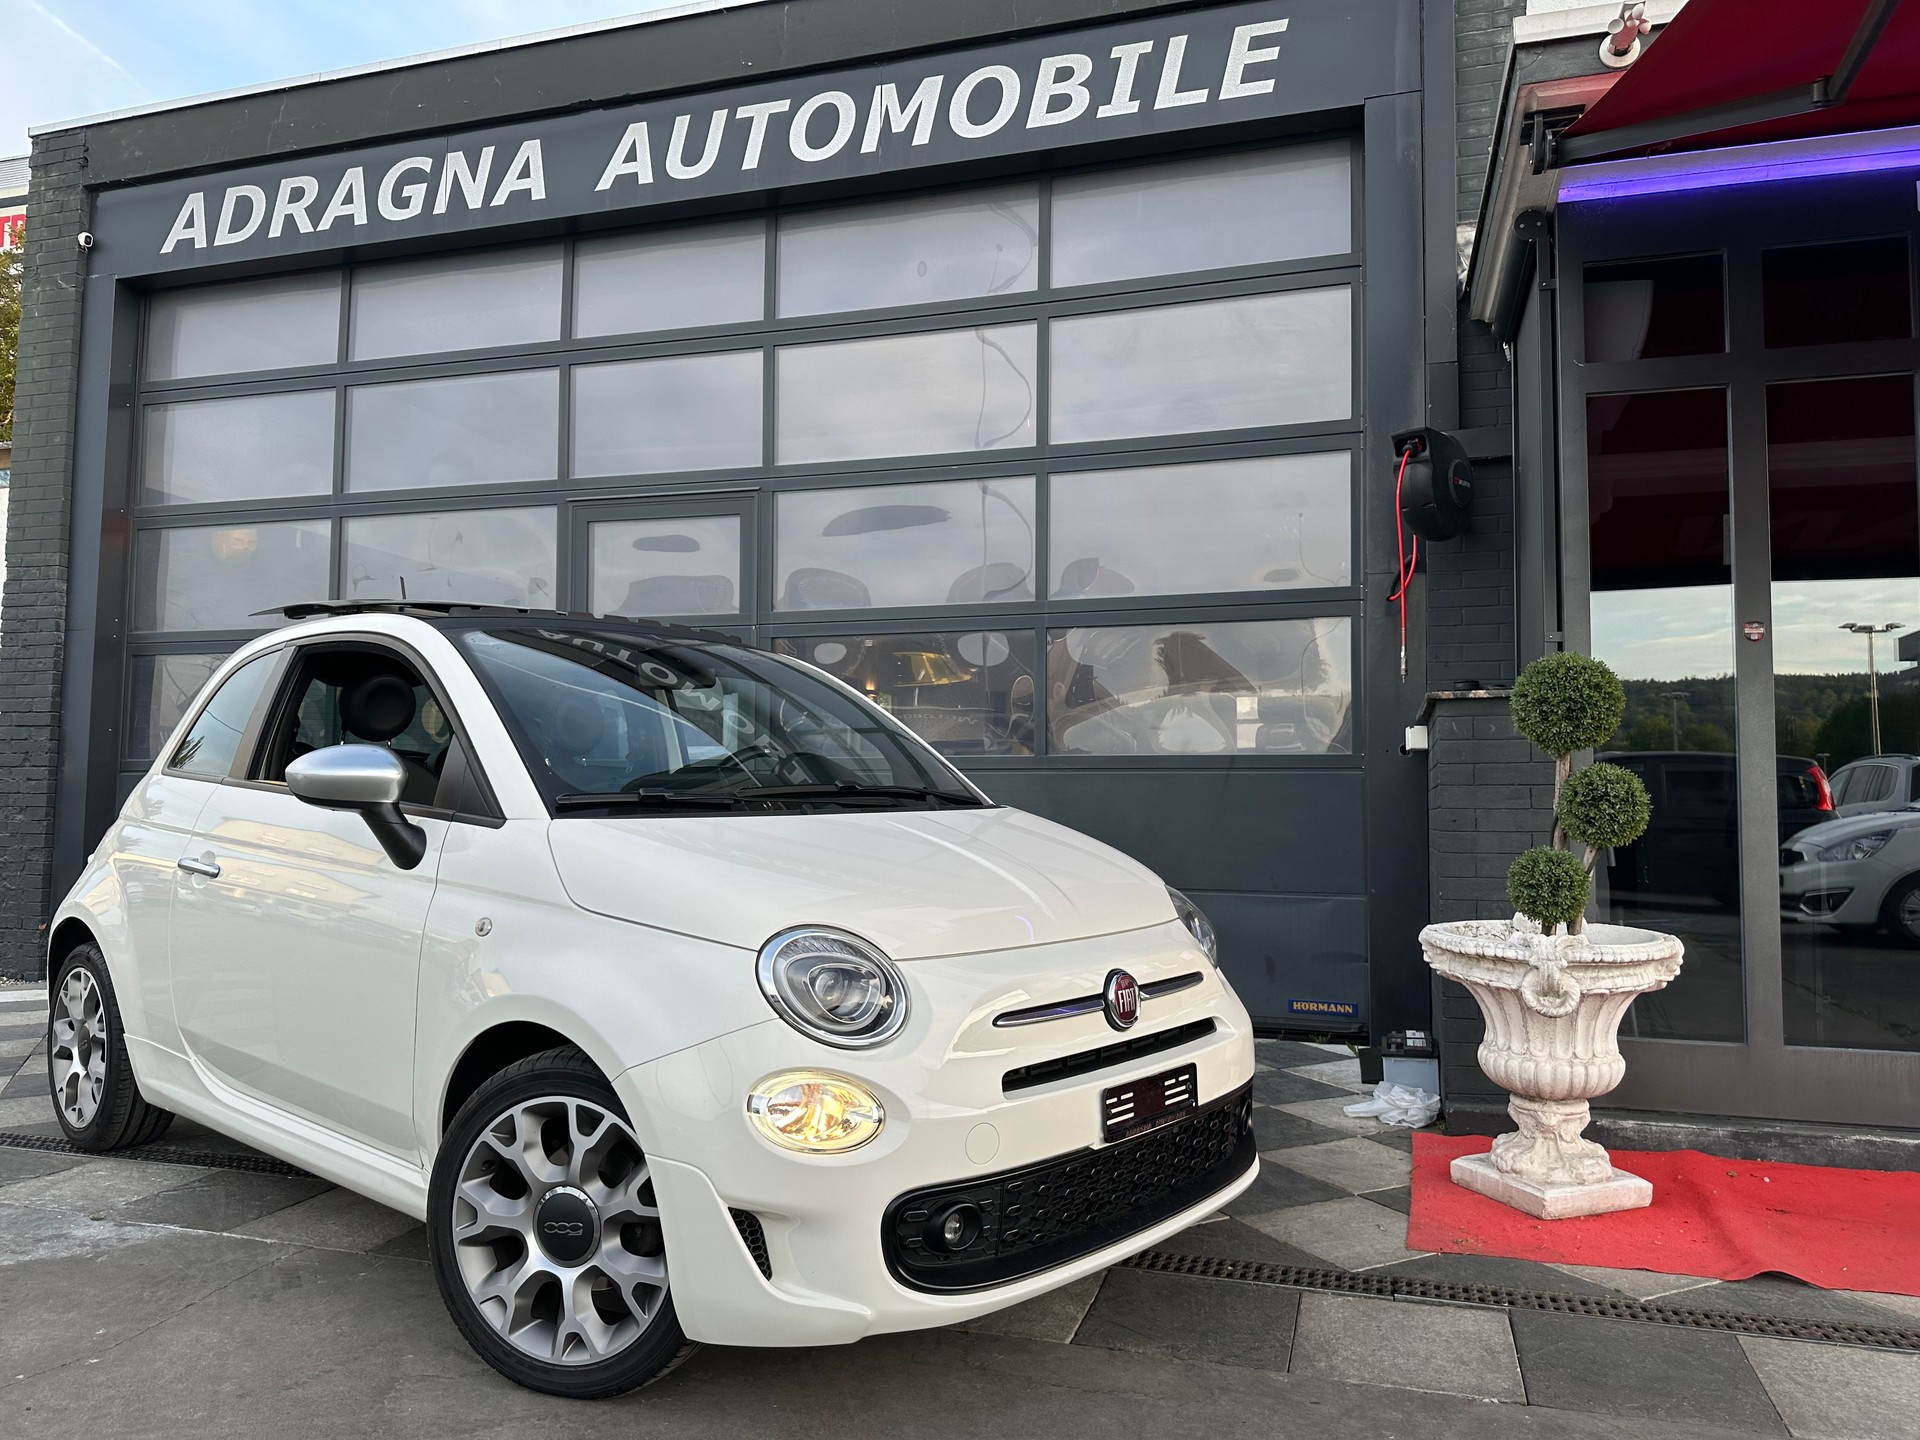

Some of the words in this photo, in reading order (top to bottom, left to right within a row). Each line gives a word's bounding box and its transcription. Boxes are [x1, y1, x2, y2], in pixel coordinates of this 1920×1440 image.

[159, 138, 547, 254] ADRAGNA
[594, 18, 1289, 191] AUTOMOBILE
[1118, 988, 1136, 1013] FIAT
[544, 1221, 583, 1236] 500
